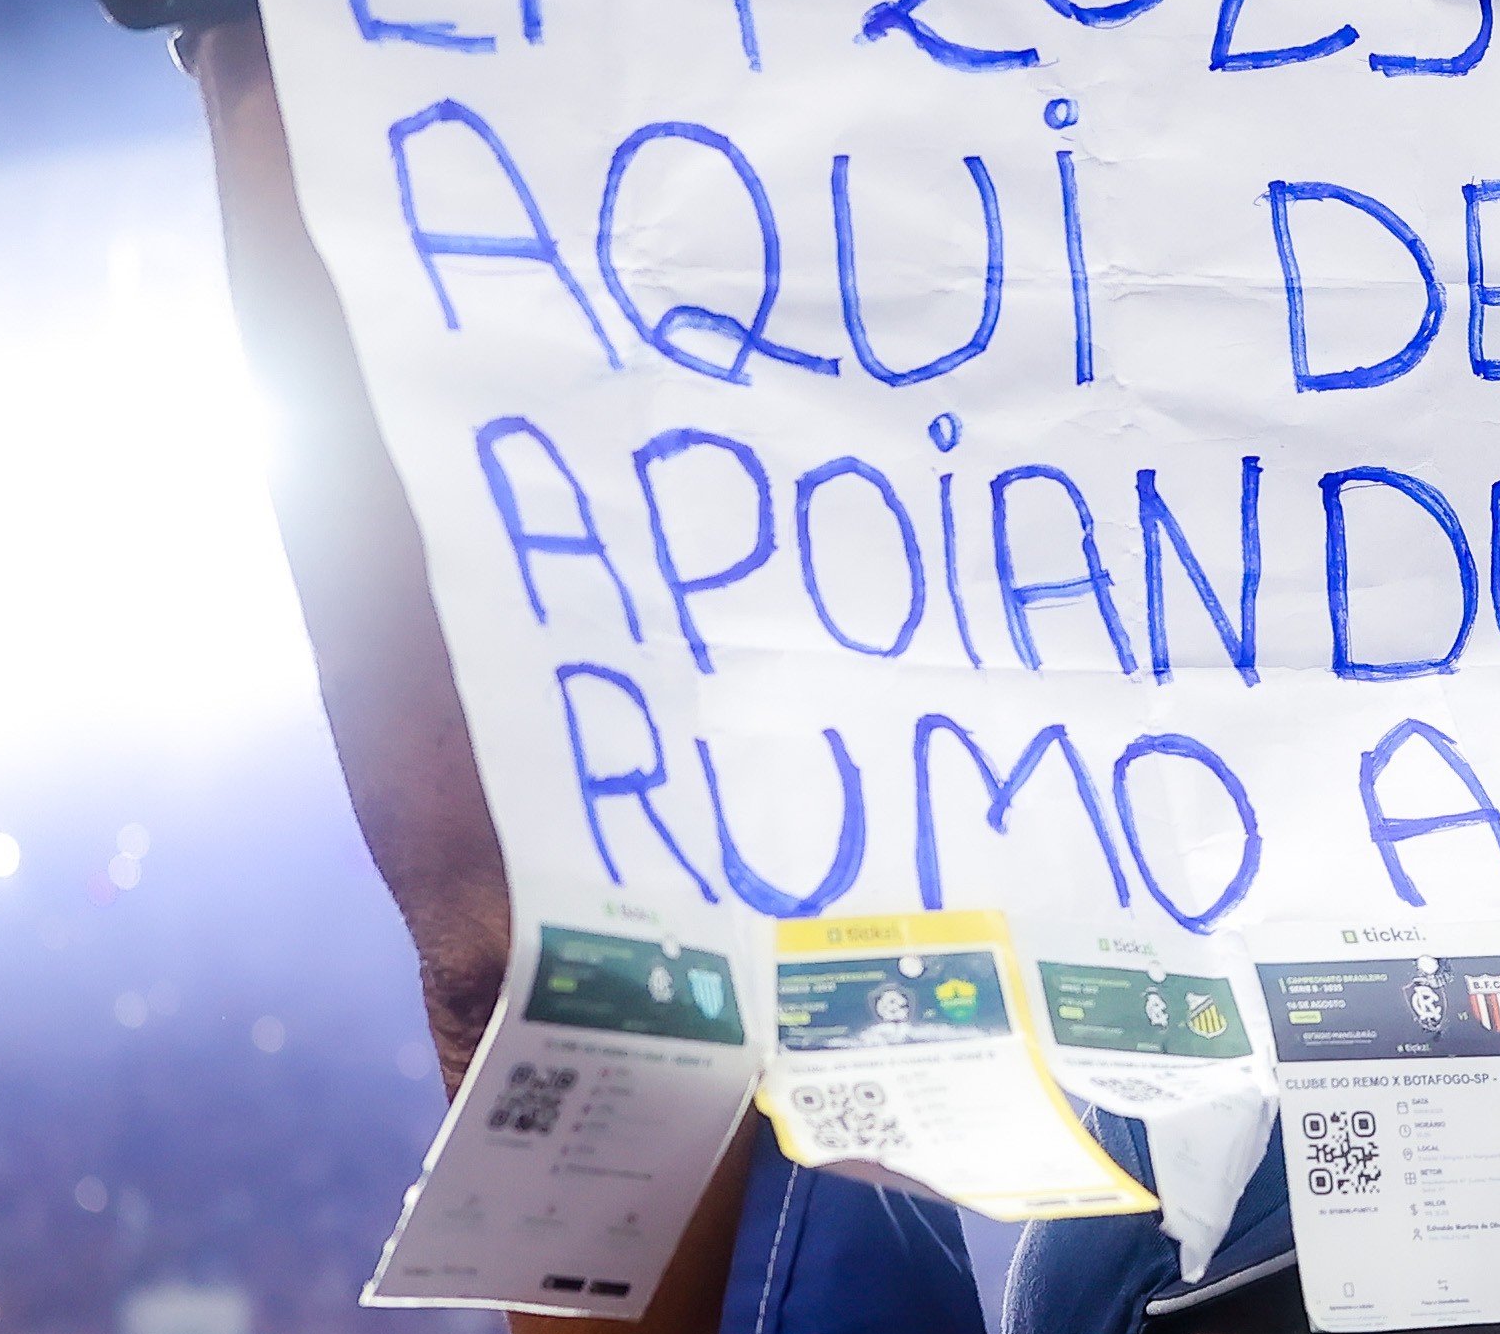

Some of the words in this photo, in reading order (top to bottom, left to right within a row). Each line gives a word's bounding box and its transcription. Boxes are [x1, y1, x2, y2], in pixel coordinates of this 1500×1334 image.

[556, 662, 1261, 931] RUMO
[1363, 927, 1427, 943] tickzi.
[1285, 1076, 1328, 1090] CLUBE
[1331, 1076, 1350, 1089] DO
[1353, 1075, 1389, 1088] REMO
[1392, 1074, 1401, 1086] X
[1403, 1072, 1490, 1086] BOTAFOGO-SP
